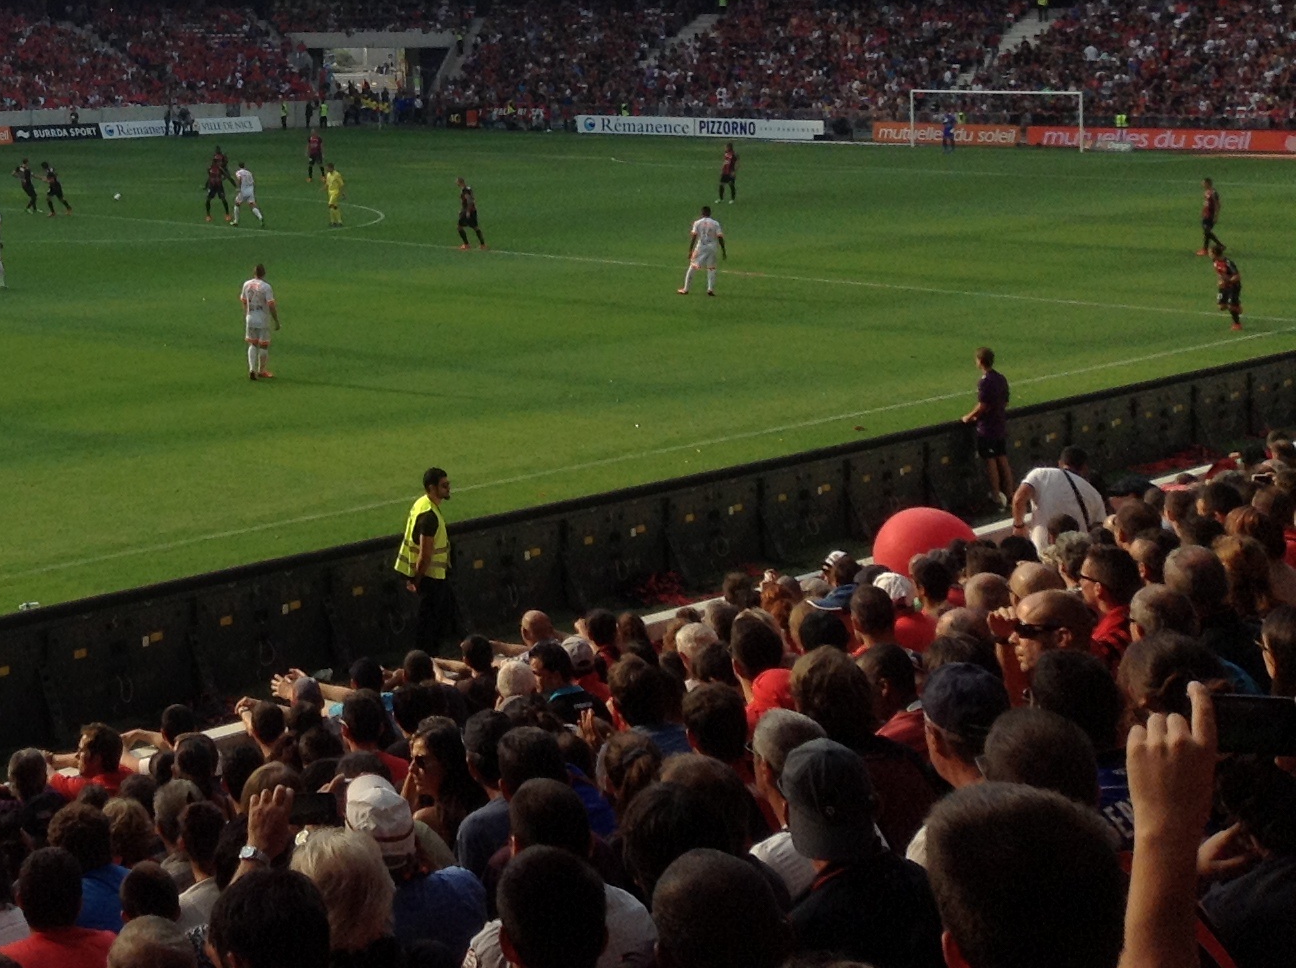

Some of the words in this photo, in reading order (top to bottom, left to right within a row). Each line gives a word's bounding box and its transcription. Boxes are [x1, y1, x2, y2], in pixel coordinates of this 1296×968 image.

[33, 128, 68, 139] BURRDA
[69, 127, 97, 137] SPORT
[601, 118, 690, 135] Rémanence
[699, 119, 755, 136] PIZZORNO
[879, 127, 946, 141] mutuelle
[954, 128, 973, 142] du
[977, 128, 1016, 143] soleil
[1154, 130, 1186, 149] du
[1192, 131, 1252, 150] soleil
